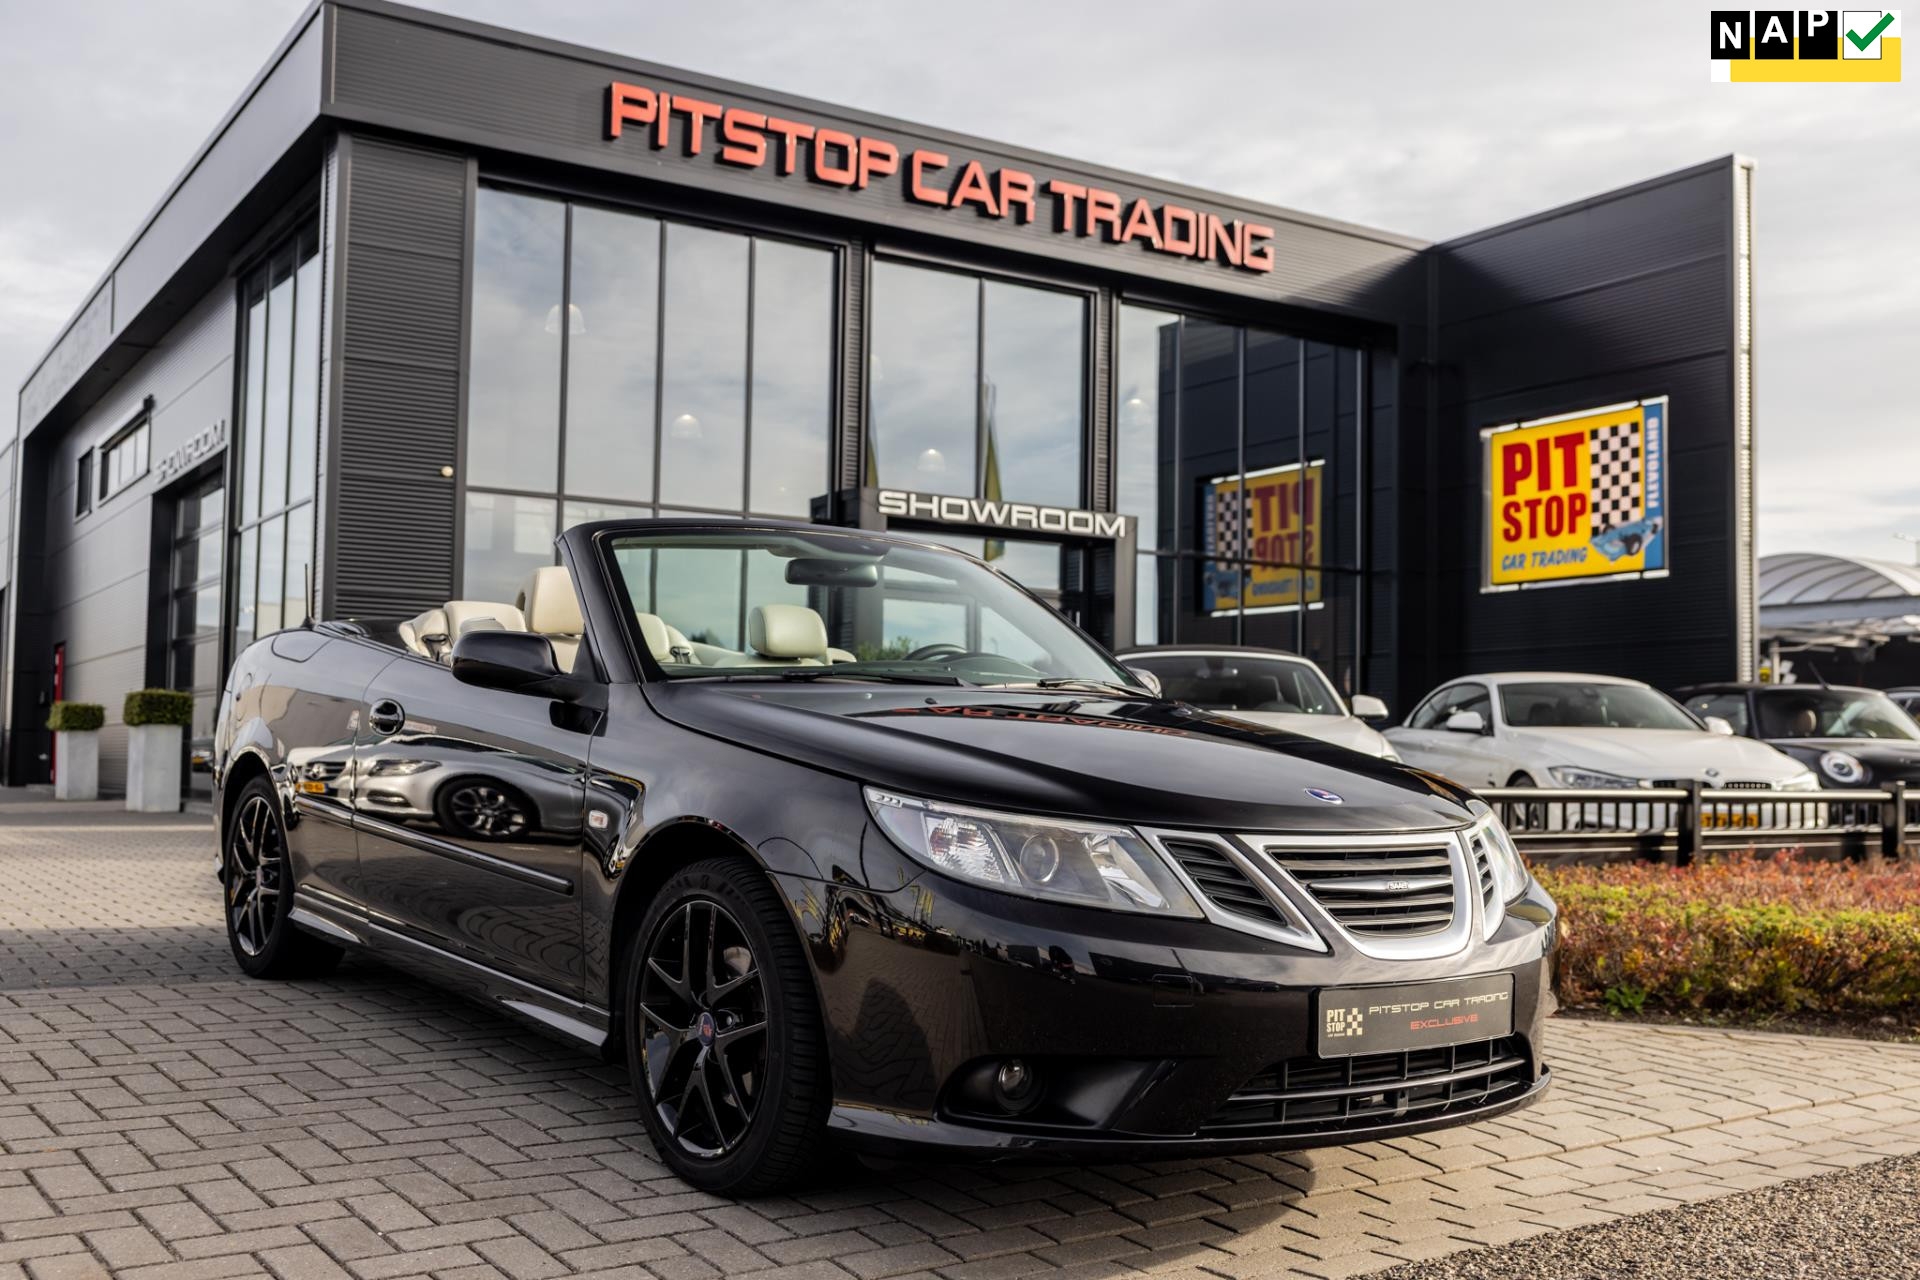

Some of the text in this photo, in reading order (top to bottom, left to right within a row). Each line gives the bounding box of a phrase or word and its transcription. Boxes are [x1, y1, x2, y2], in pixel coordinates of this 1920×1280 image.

[608, 81, 1275, 273] PITSTOP CAR TRADING
[1502, 431, 1585, 497] PIT
[878, 490, 1126, 538] SHOWROOM
[1502, 492, 1587, 543] STOP
[1502, 546, 1588, 571] CAR TRADING
[1326, 1008, 1346, 1022] PIT
[1369, 991, 1509, 1015] PITSTOP CAR TRADING
[1326, 1021, 1346, 1033] STOP
[1410, 1013, 1479, 1031] EXCLUSIVE
